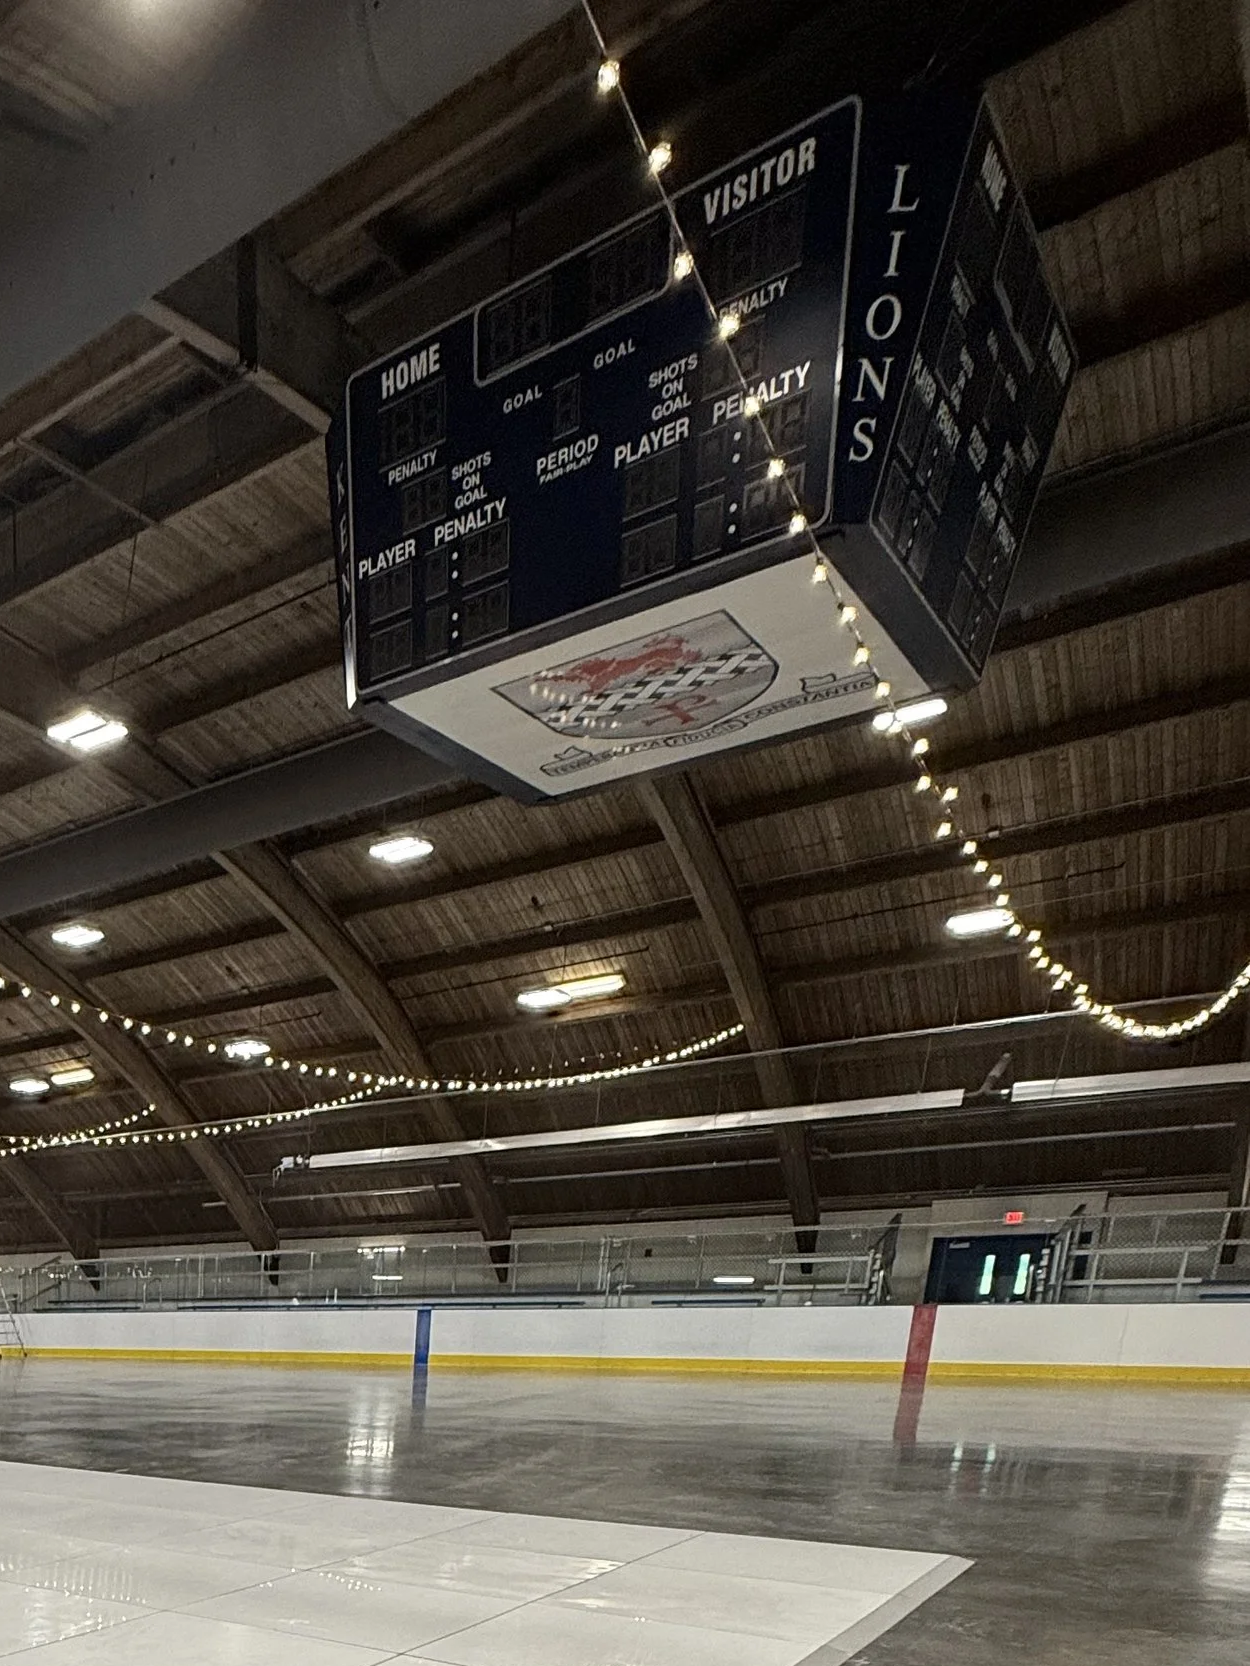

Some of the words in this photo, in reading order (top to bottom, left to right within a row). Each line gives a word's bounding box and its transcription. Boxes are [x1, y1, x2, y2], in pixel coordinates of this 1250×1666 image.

[703, 137, 817, 225] VISITOR
[718, 276, 788, 320] PENALTY
[848, 164, 919, 463] LIONS
[381, 343, 441, 400] HOME
[593, 338, 636, 370] GOAL
[648, 352, 699, 388] SHOTS
[503, 385, 543, 414] GOAL
[662, 377, 684, 399] ON
[651, 392, 692, 421] GOAL
[536, 433, 600, 476] PERIOD
[613, 416, 690, 469] PLAYER
[388, 450, 438, 487] PENALTY
[451, 452, 492, 481] SHOTS
[462, 472, 480, 490] ON
[455, 485, 488, 510] GOAL
[358, 539, 416, 580] PLAYER
[434, 497, 507, 547] PENALTY
